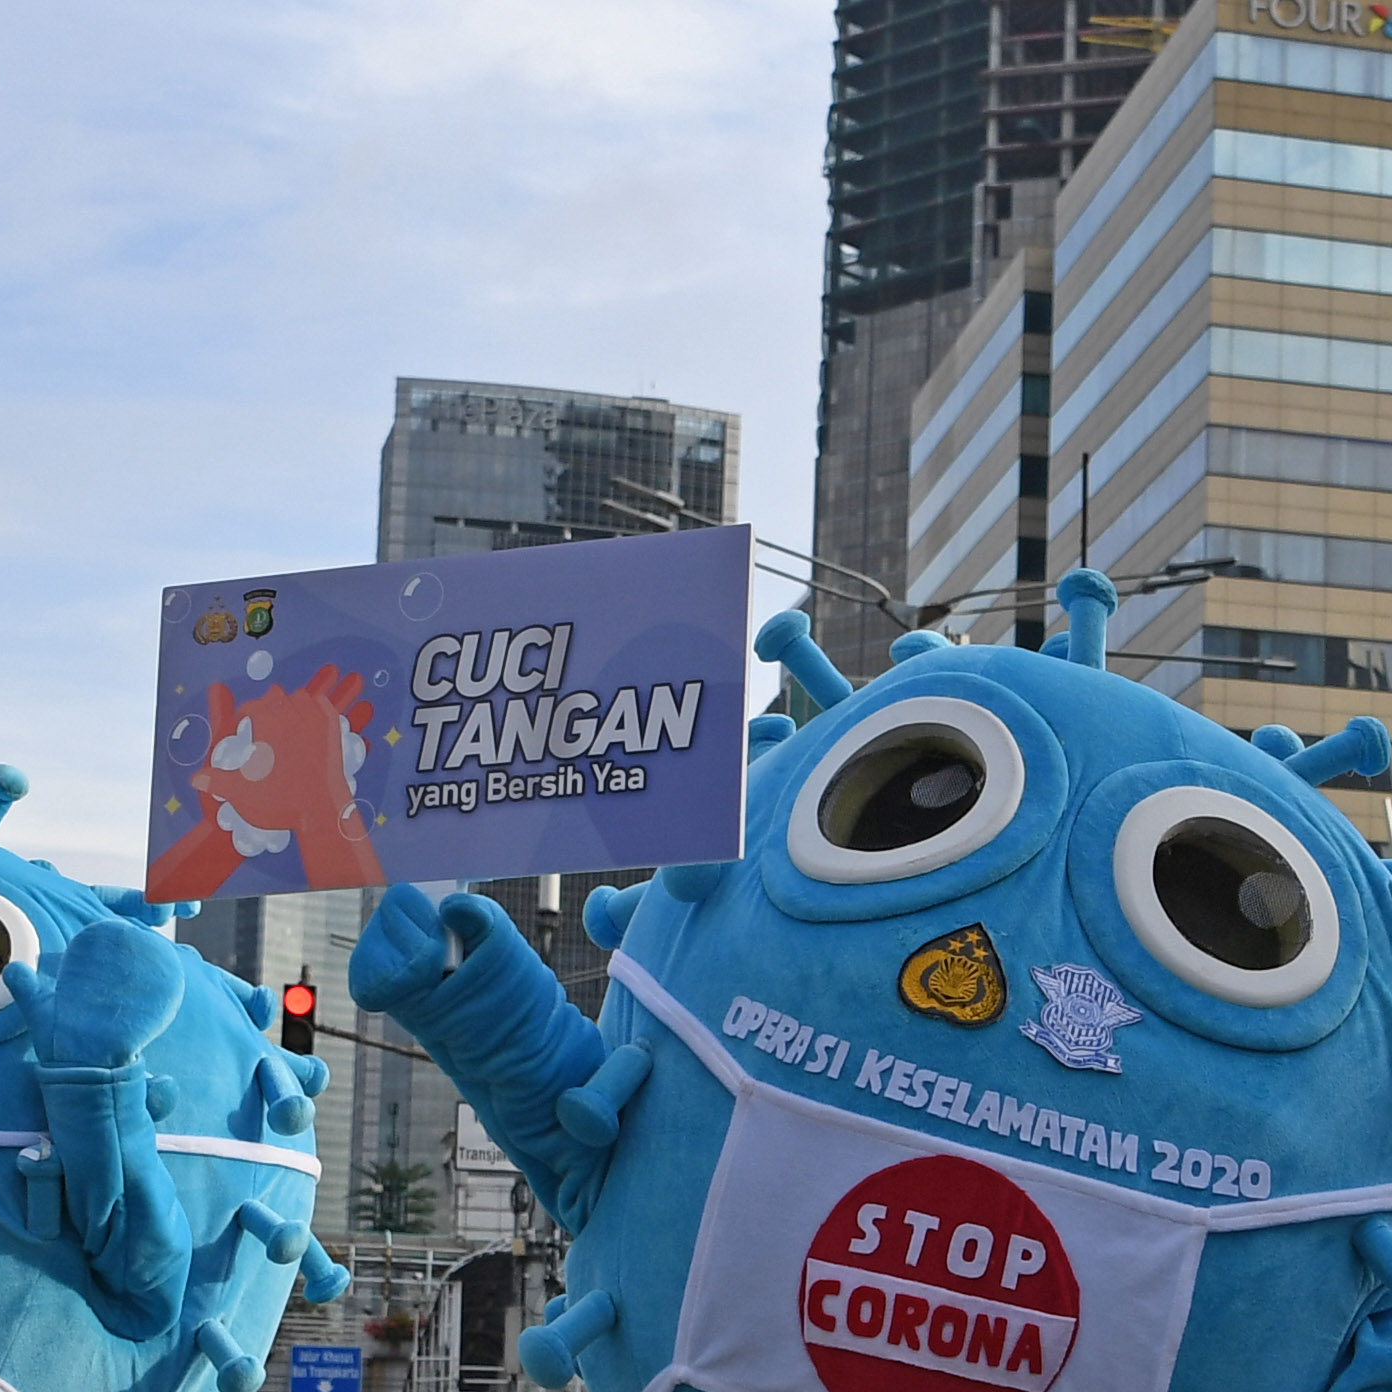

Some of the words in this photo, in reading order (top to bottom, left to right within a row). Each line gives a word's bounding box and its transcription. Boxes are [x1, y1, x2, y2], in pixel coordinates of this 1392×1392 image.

[1248, 0, 1365, 36] FOUR
[412, 622, 574, 702] CUCI
[412, 681, 703, 772] TANGAN
[407, 777, 477, 817] yang
[487, 767, 584, 802] Bersih
[592, 763, 645, 792] Yaa
[721, 995, 850, 1081] OPERASI
[855, 1049, 1140, 1174] KESELAMATAN
[1151, 1139, 1273, 1199] 2020
[459, 1146, 507, 1165] Transja
[848, 1203, 1047, 1291] STOP
[807, 1278, 1043, 1375] CORONA
